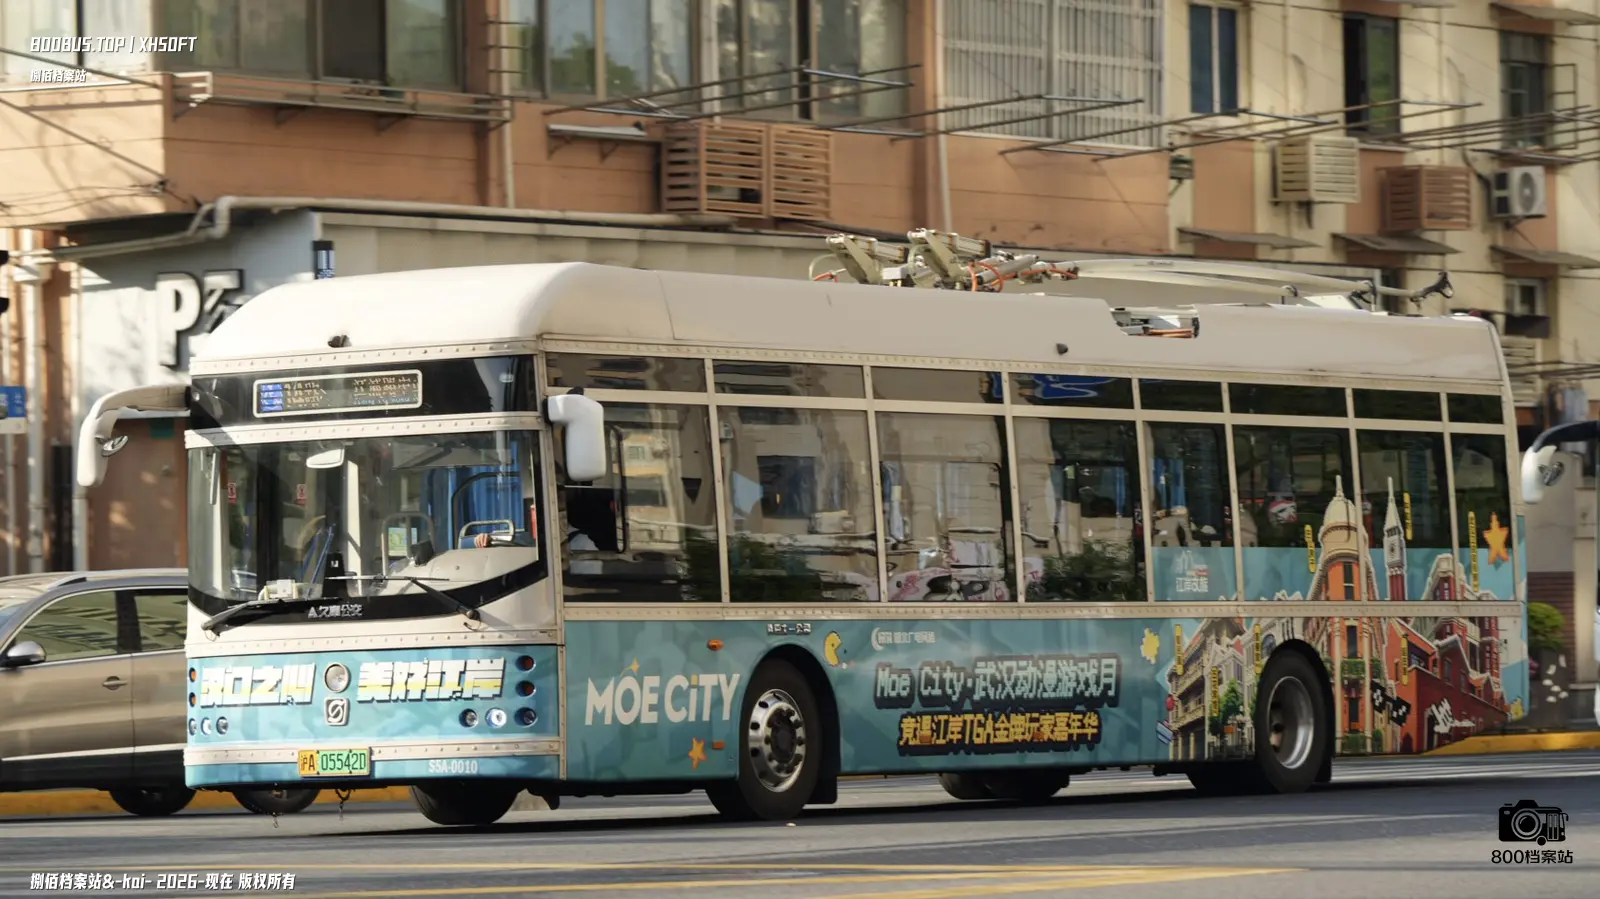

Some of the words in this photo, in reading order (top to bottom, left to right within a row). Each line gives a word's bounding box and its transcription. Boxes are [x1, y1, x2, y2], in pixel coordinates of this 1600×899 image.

[357, 658, 506, 703] 美好江岸
[584, 673, 661, 727] MOE
[876, 666, 911, 698] Moe
